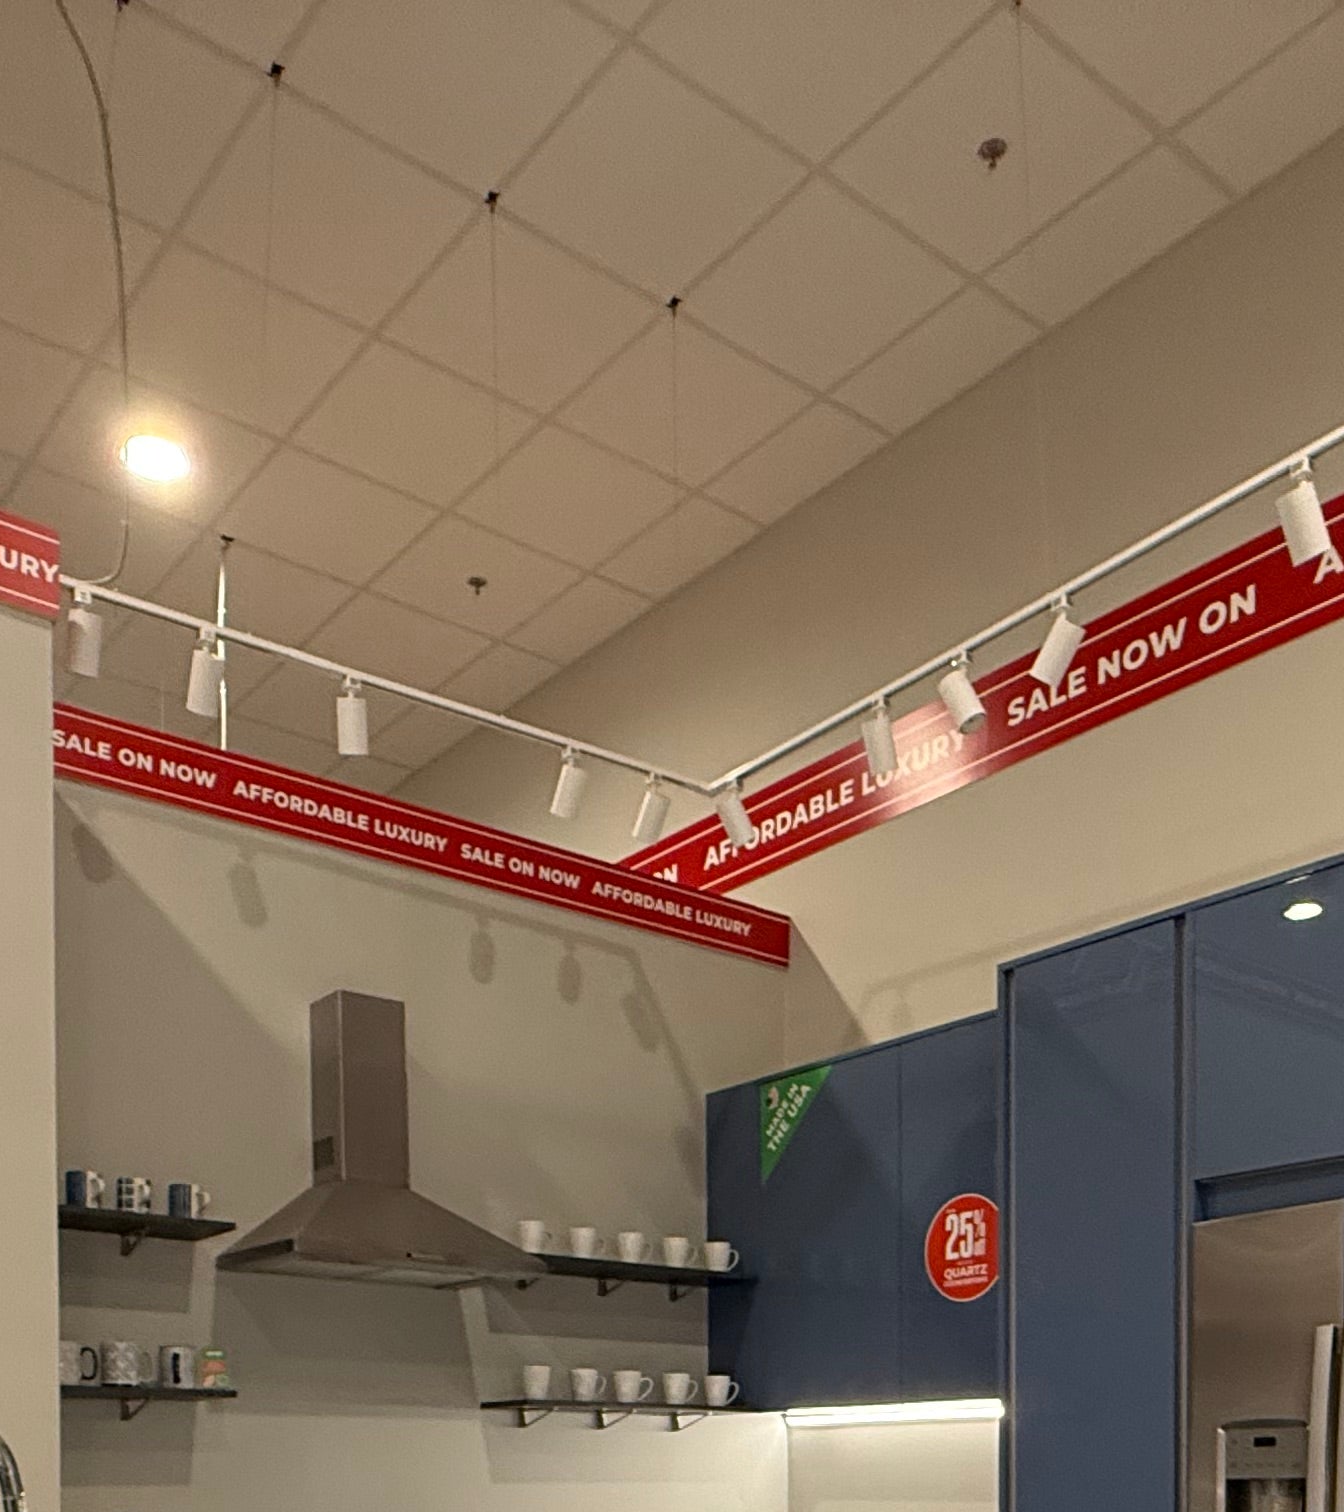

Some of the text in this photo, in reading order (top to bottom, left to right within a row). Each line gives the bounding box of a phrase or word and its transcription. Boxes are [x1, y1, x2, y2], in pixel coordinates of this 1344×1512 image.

[1007, 584, 1256, 728] SALE NOW ON
[52, 729, 217, 789] SALE ON NOW
[233, 780, 448, 851] AFFORDABLE LUXURY
[460, 843, 580, 889] SALE ON NOW
[591, 881, 751, 936] AFFORDABLE LUXURY
[943, 1264, 989, 1280] QUARTZ
